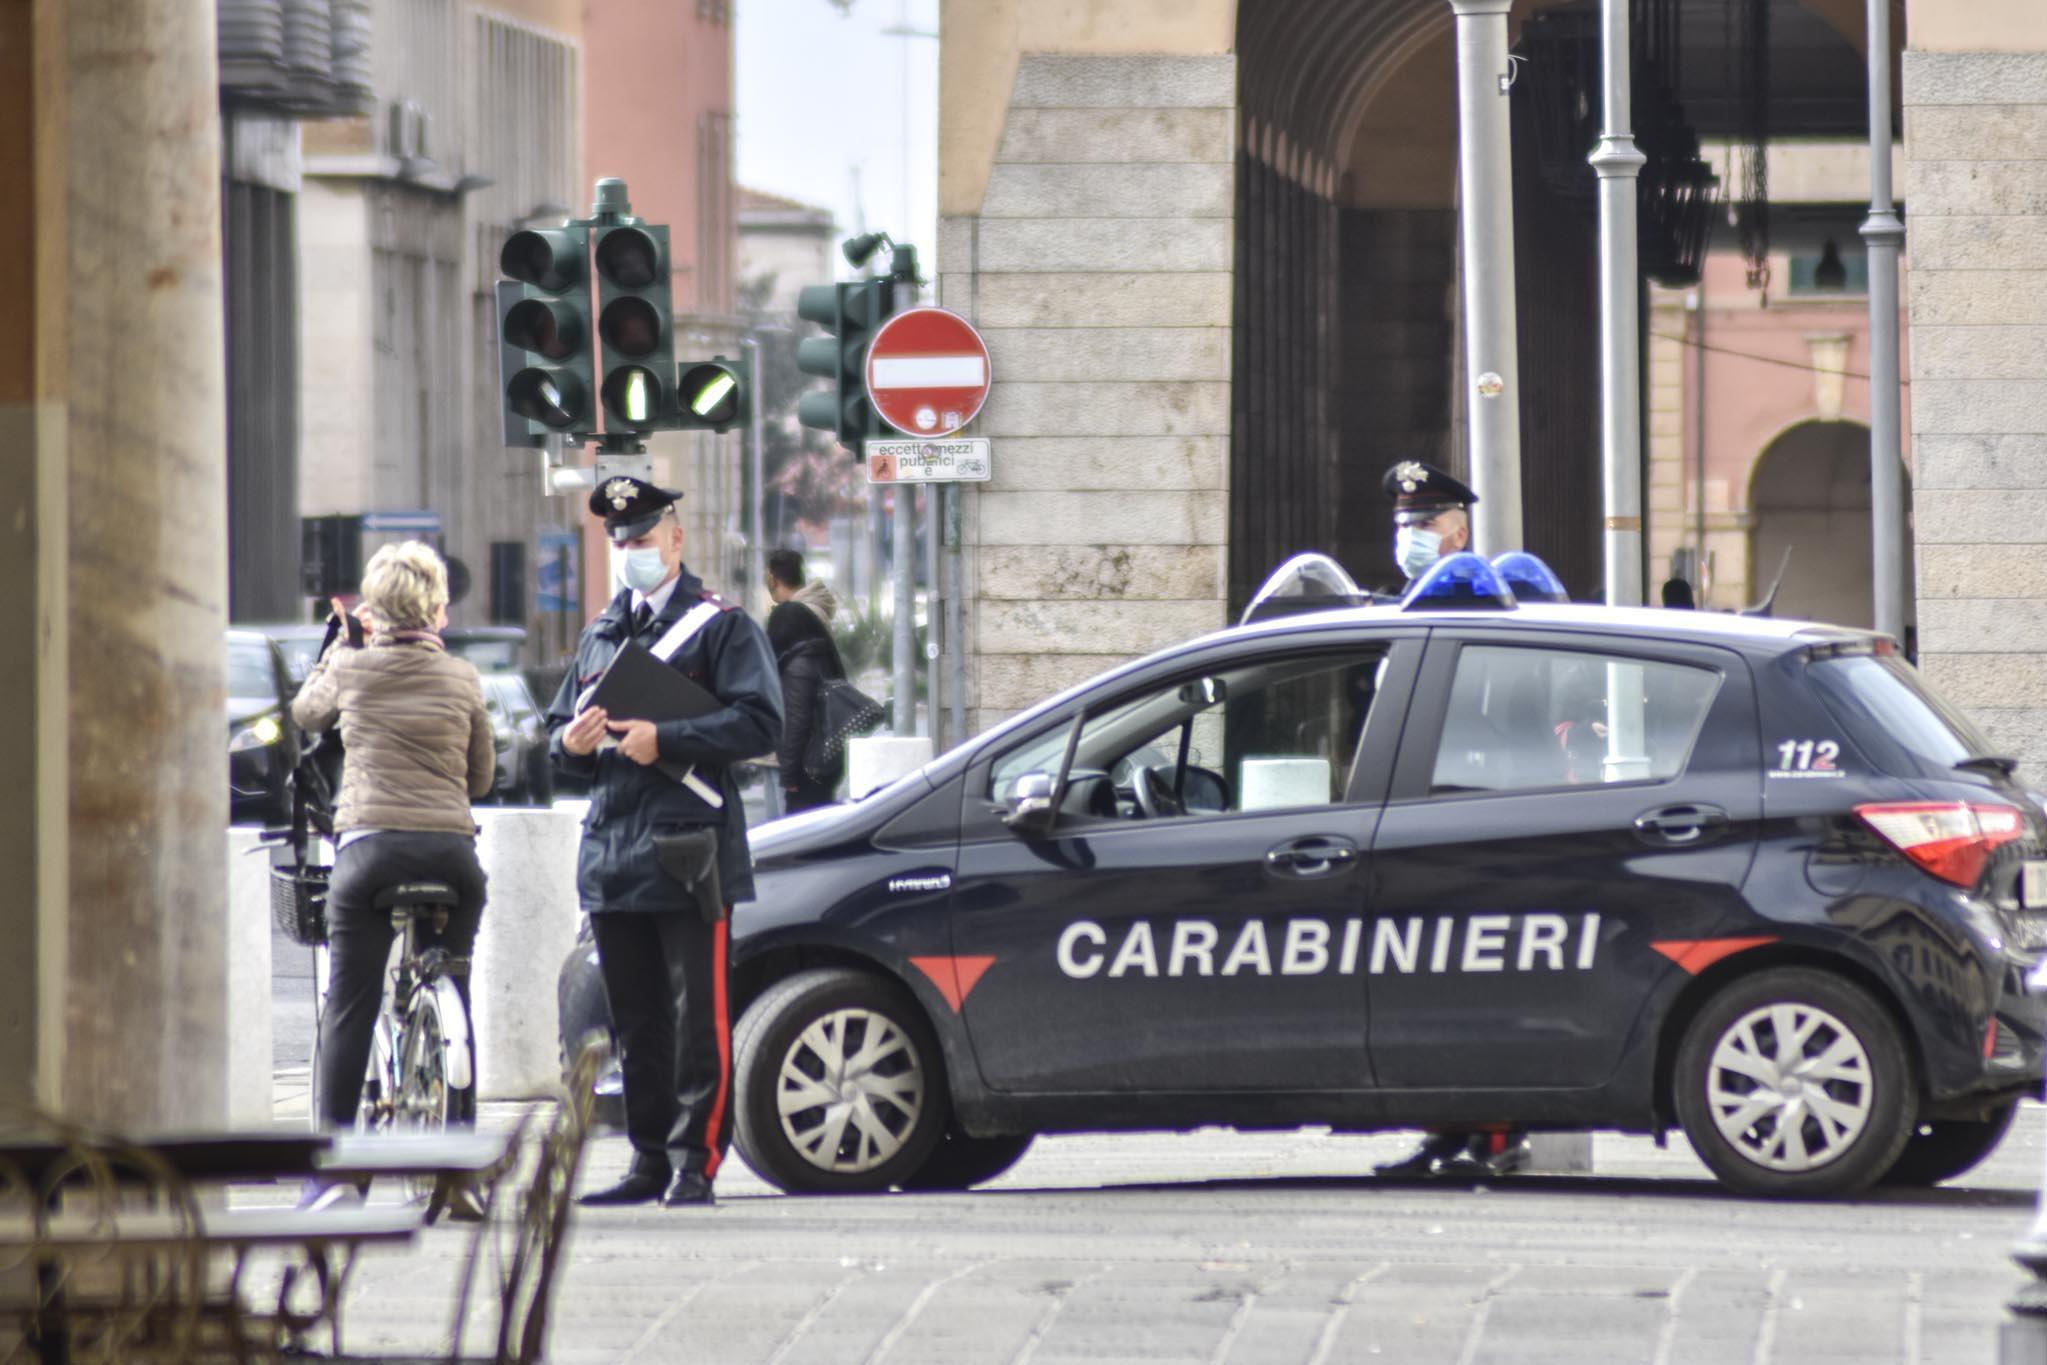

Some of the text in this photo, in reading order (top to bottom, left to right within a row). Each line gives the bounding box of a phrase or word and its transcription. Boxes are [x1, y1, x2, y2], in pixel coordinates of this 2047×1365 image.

[879, 444, 929, 456] eccett
[924, 466, 933, 476] e
[1777, 739, 1841, 770] 112
[1057, 913, 1601, 979] CARABINIERI
